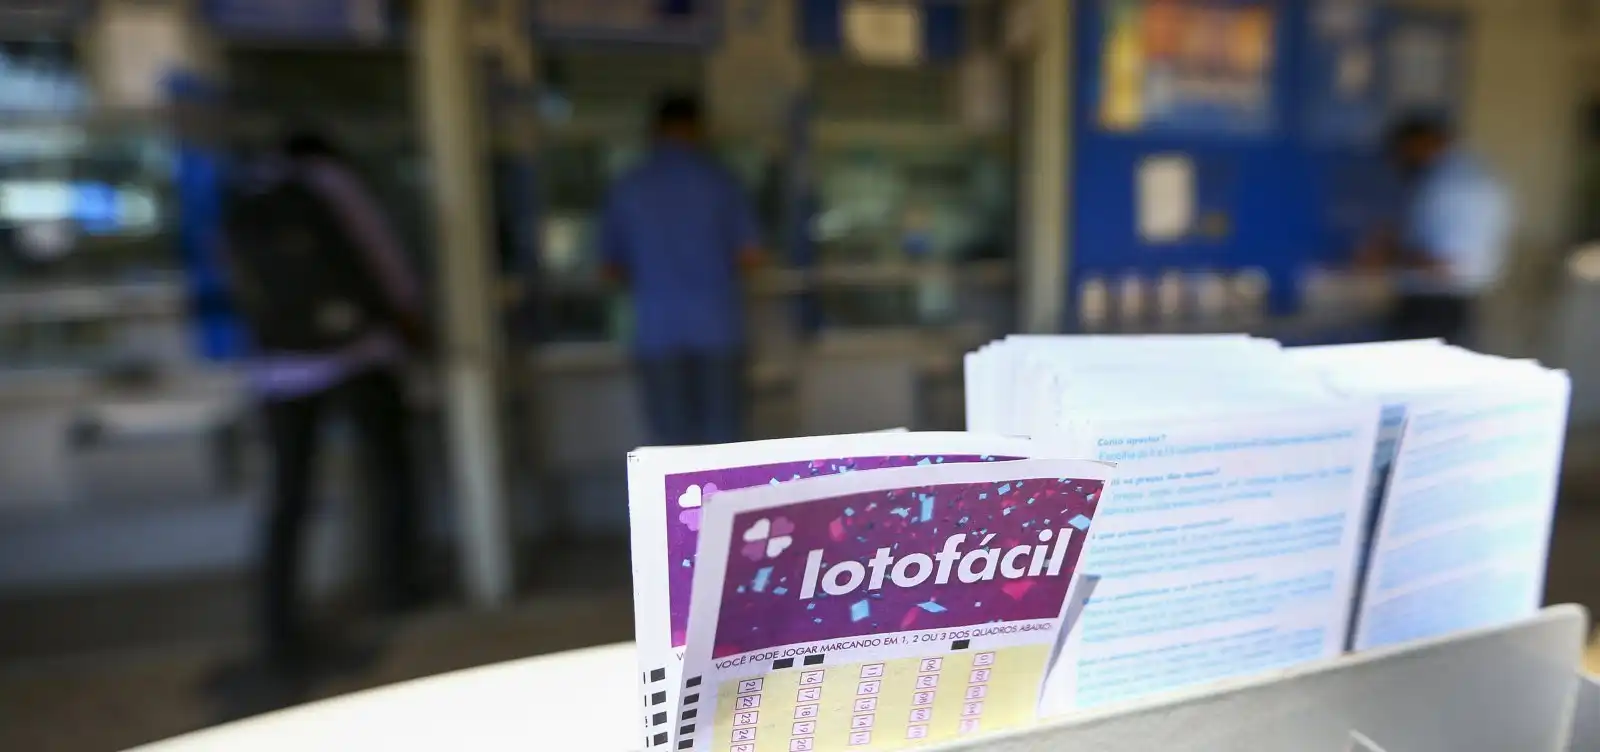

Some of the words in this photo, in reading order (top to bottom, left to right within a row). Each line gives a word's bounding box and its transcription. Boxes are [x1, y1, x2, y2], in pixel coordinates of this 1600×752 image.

[799, 527, 1073, 600] lotofácil
[715, 656, 746, 670] VOCÊ
[749, 651, 780, 664] PODE
[781, 646, 818, 658] JOGAR
[819, 638, 881, 652] MARCANDO
[884, 637, 898, 646] EM
[901, 636, 909, 645] 1,
[912, 635, 919, 643] 2
[921, 633, 938, 642] OU
[940, 632, 946, 640] 3
[949, 631, 970, 640] DOS
[971, 625, 1018, 638] QUADROS
[927, 659, 936, 670] 06
[867, 667, 878, 675] 11
[806, 673, 817, 682] 16
[923, 676, 932, 686] 07
[745, 681, 756, 690] 21
[864, 683, 874, 692] 12
[804, 688, 815, 698] 17
[743, 697, 753, 707] 22
[860, 700, 871, 710] 13
[802, 707, 811, 716] 18
[741, 713, 751, 724] 23
[800, 723, 809, 733] 19
[739, 730, 749, 739] 24
[797, 740, 806, 750] 20
